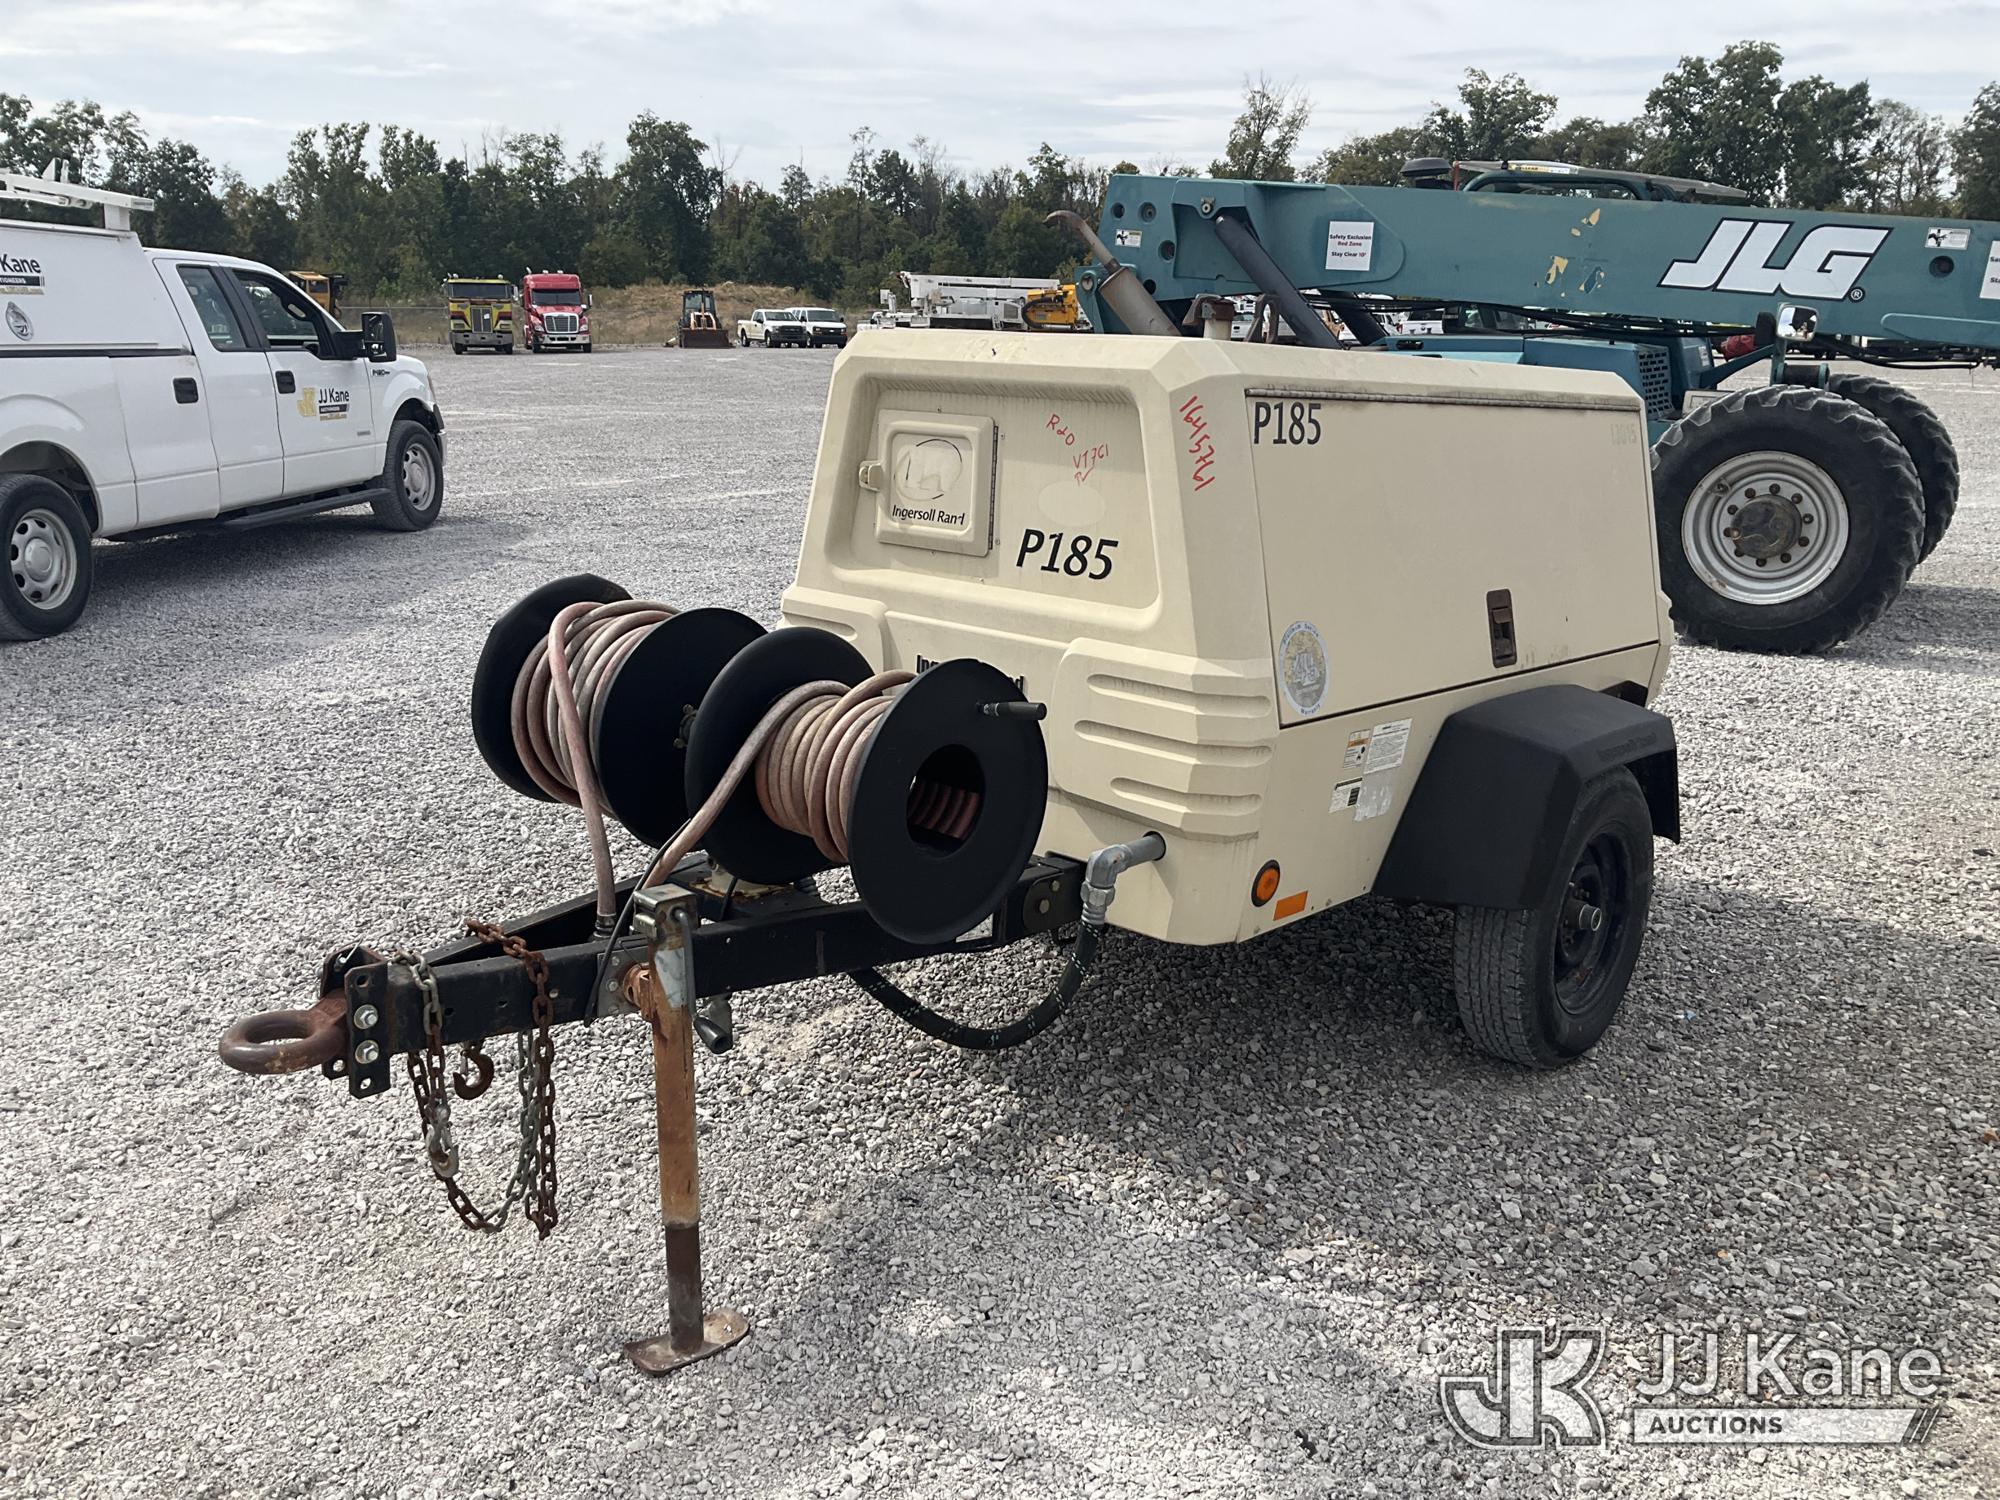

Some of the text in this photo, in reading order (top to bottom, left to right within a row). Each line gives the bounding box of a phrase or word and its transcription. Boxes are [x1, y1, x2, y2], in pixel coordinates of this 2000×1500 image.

[0, 253, 41, 274] Kane
[1657, 217, 1894, 301] JLG
[318, 387, 350, 404] JJ Kane
[1253, 401, 1322, 445] P185
[892, 504, 936, 521] Ingersoll
[1016, 528, 1119, 580] P185
